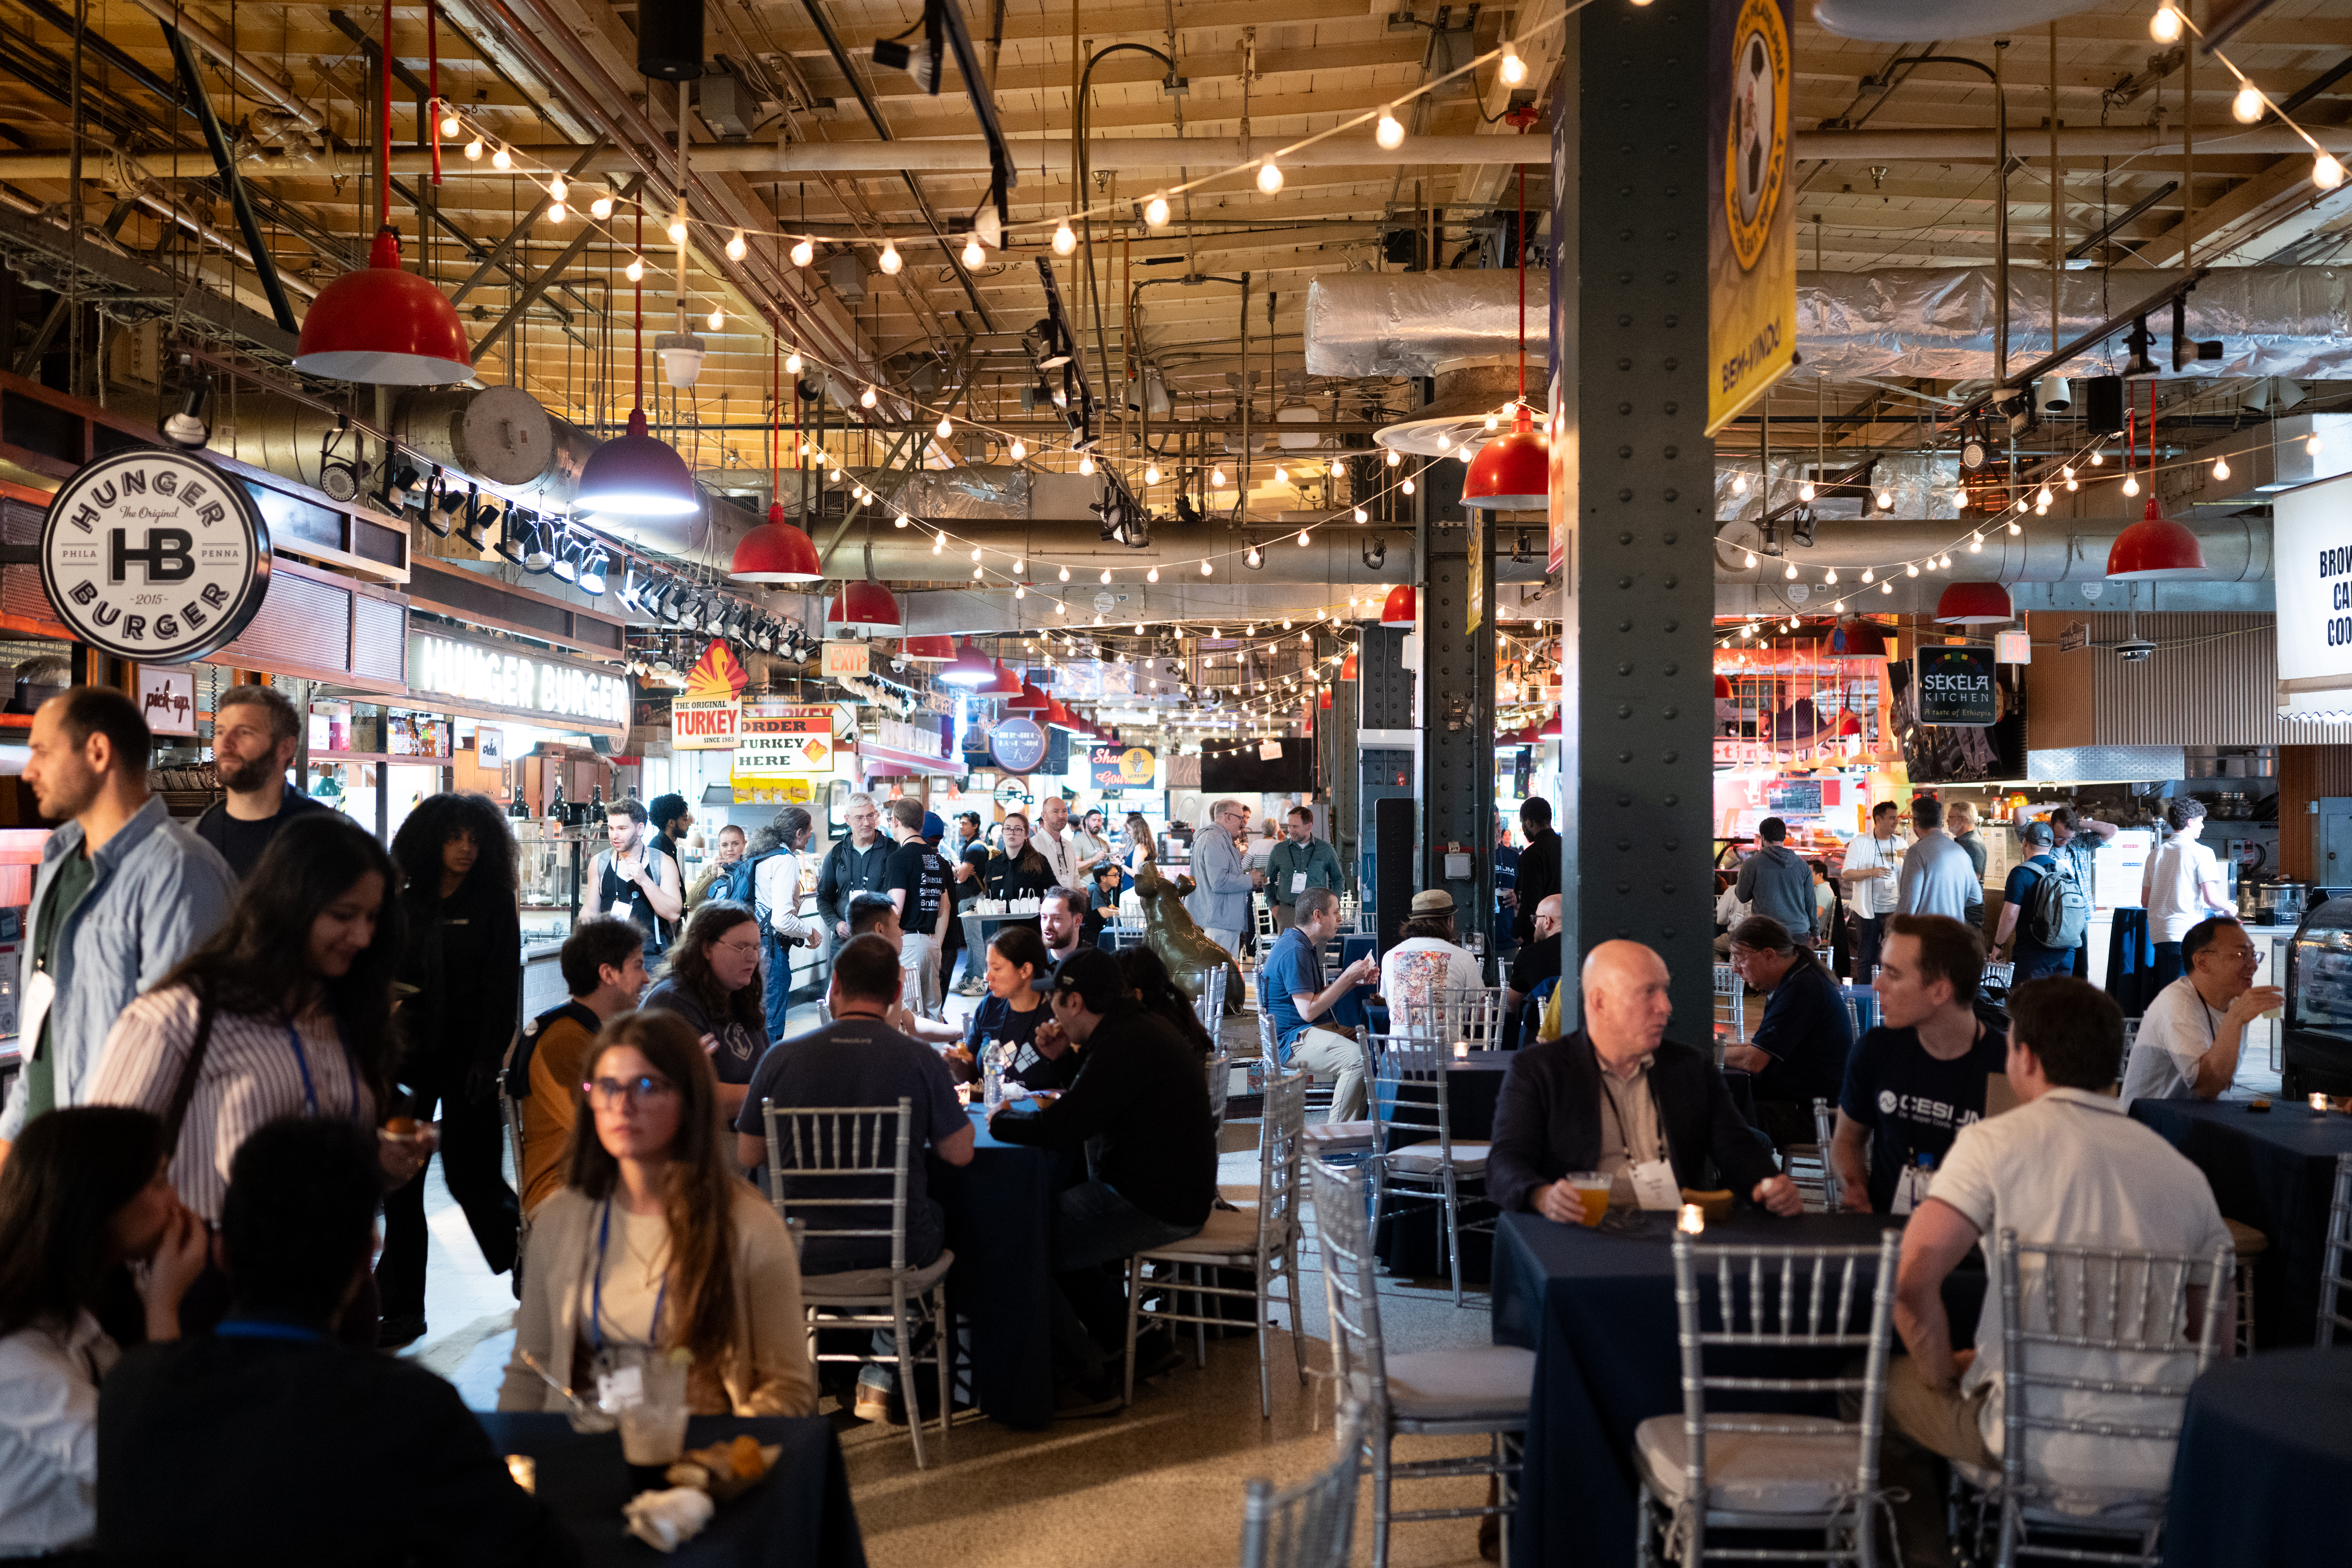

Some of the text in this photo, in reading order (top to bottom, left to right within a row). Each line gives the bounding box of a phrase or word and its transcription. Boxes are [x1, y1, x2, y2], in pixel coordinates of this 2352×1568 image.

[1722, 316, 1782, 394] BEM-VINDO
[71, 469, 225, 534] HUNGER
[120, 506, 179, 523] The Original
[107, 528, 195, 586] HB
[2334, 581, 2352, 611] CA
[68, 579, 230, 641] BURGER
[830, 646, 863, 671] EXIT
[2005, 635, 2027, 661] EXIT
[424, 636, 625, 722] HUNGER BURGER
[692, 700, 727, 709] ORIGINAL
[1925, 693, 1989, 702] KITCHEN
[675, 709, 739, 735] TURKEY
[1952, 709, 1960, 717] of
[1962, 709, 1991, 717] Ethiopia
[742, 721, 807, 732] ORDER
[483, 737, 497, 757] order
[742, 738, 804, 748] TURKEY
[739, 756, 790, 766] HERE
[921, 899, 940, 908] Bntley
